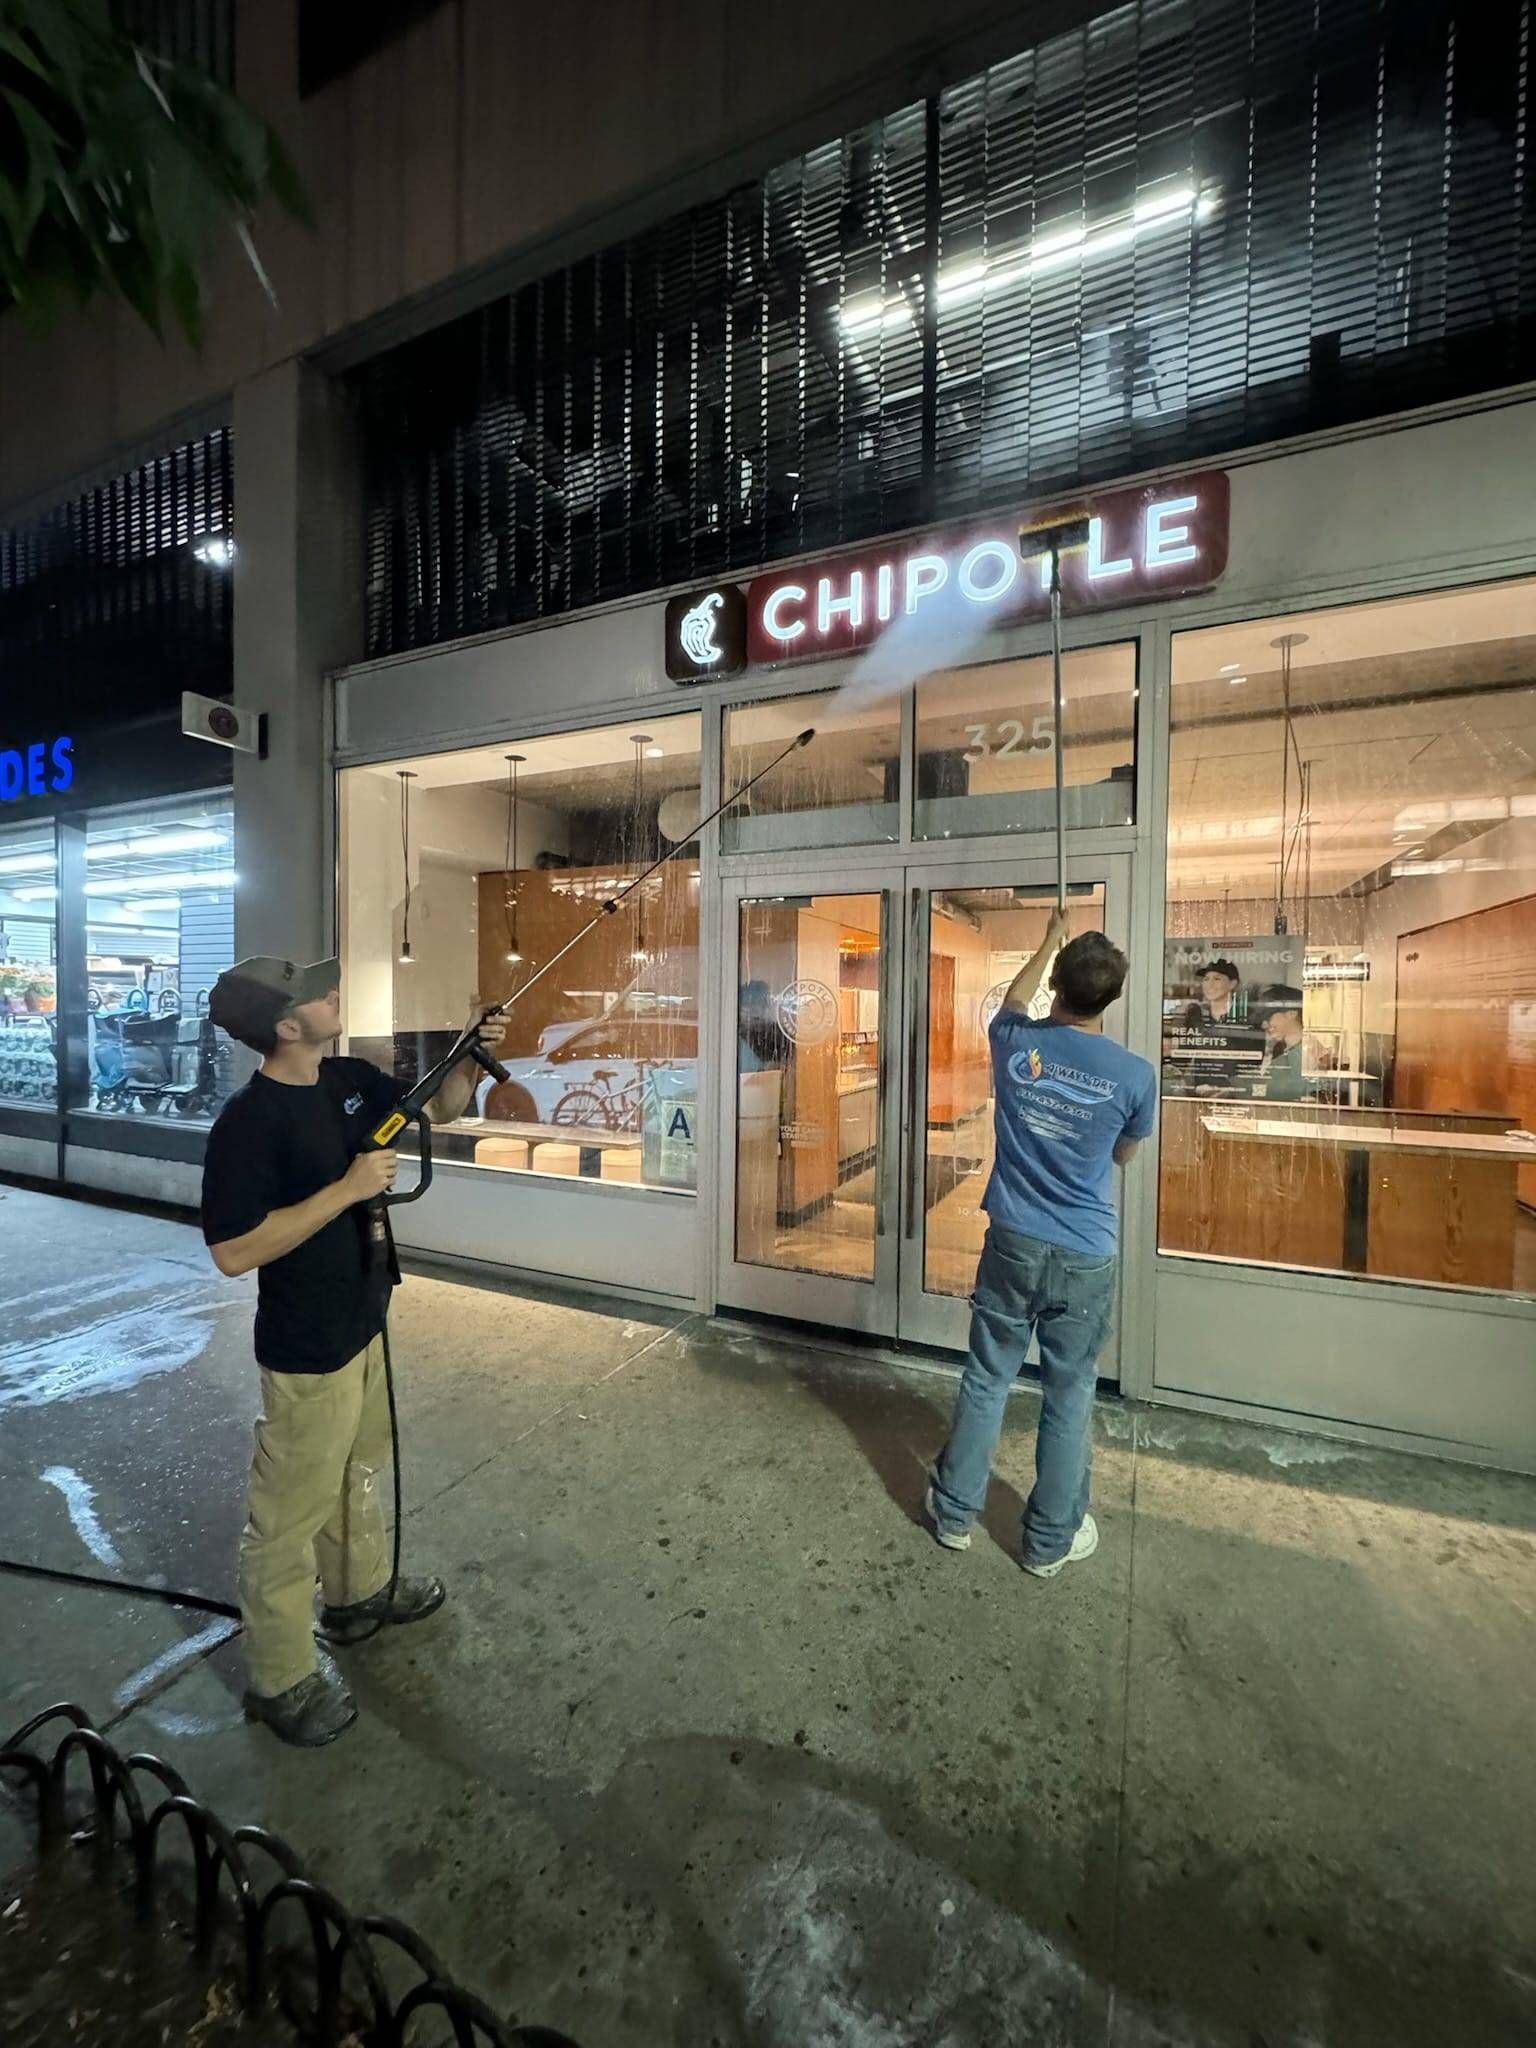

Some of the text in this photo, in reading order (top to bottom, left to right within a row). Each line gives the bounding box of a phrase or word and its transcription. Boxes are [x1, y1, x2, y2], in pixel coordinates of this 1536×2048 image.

[962, 716, 1056, 762] 325
[1226, 950, 1294, 964] HIRING
[1171, 1027, 1202, 1036] REAL
[1171, 1037, 1228, 1047] BENEFITS
[668, 1107, 691, 1139] A
